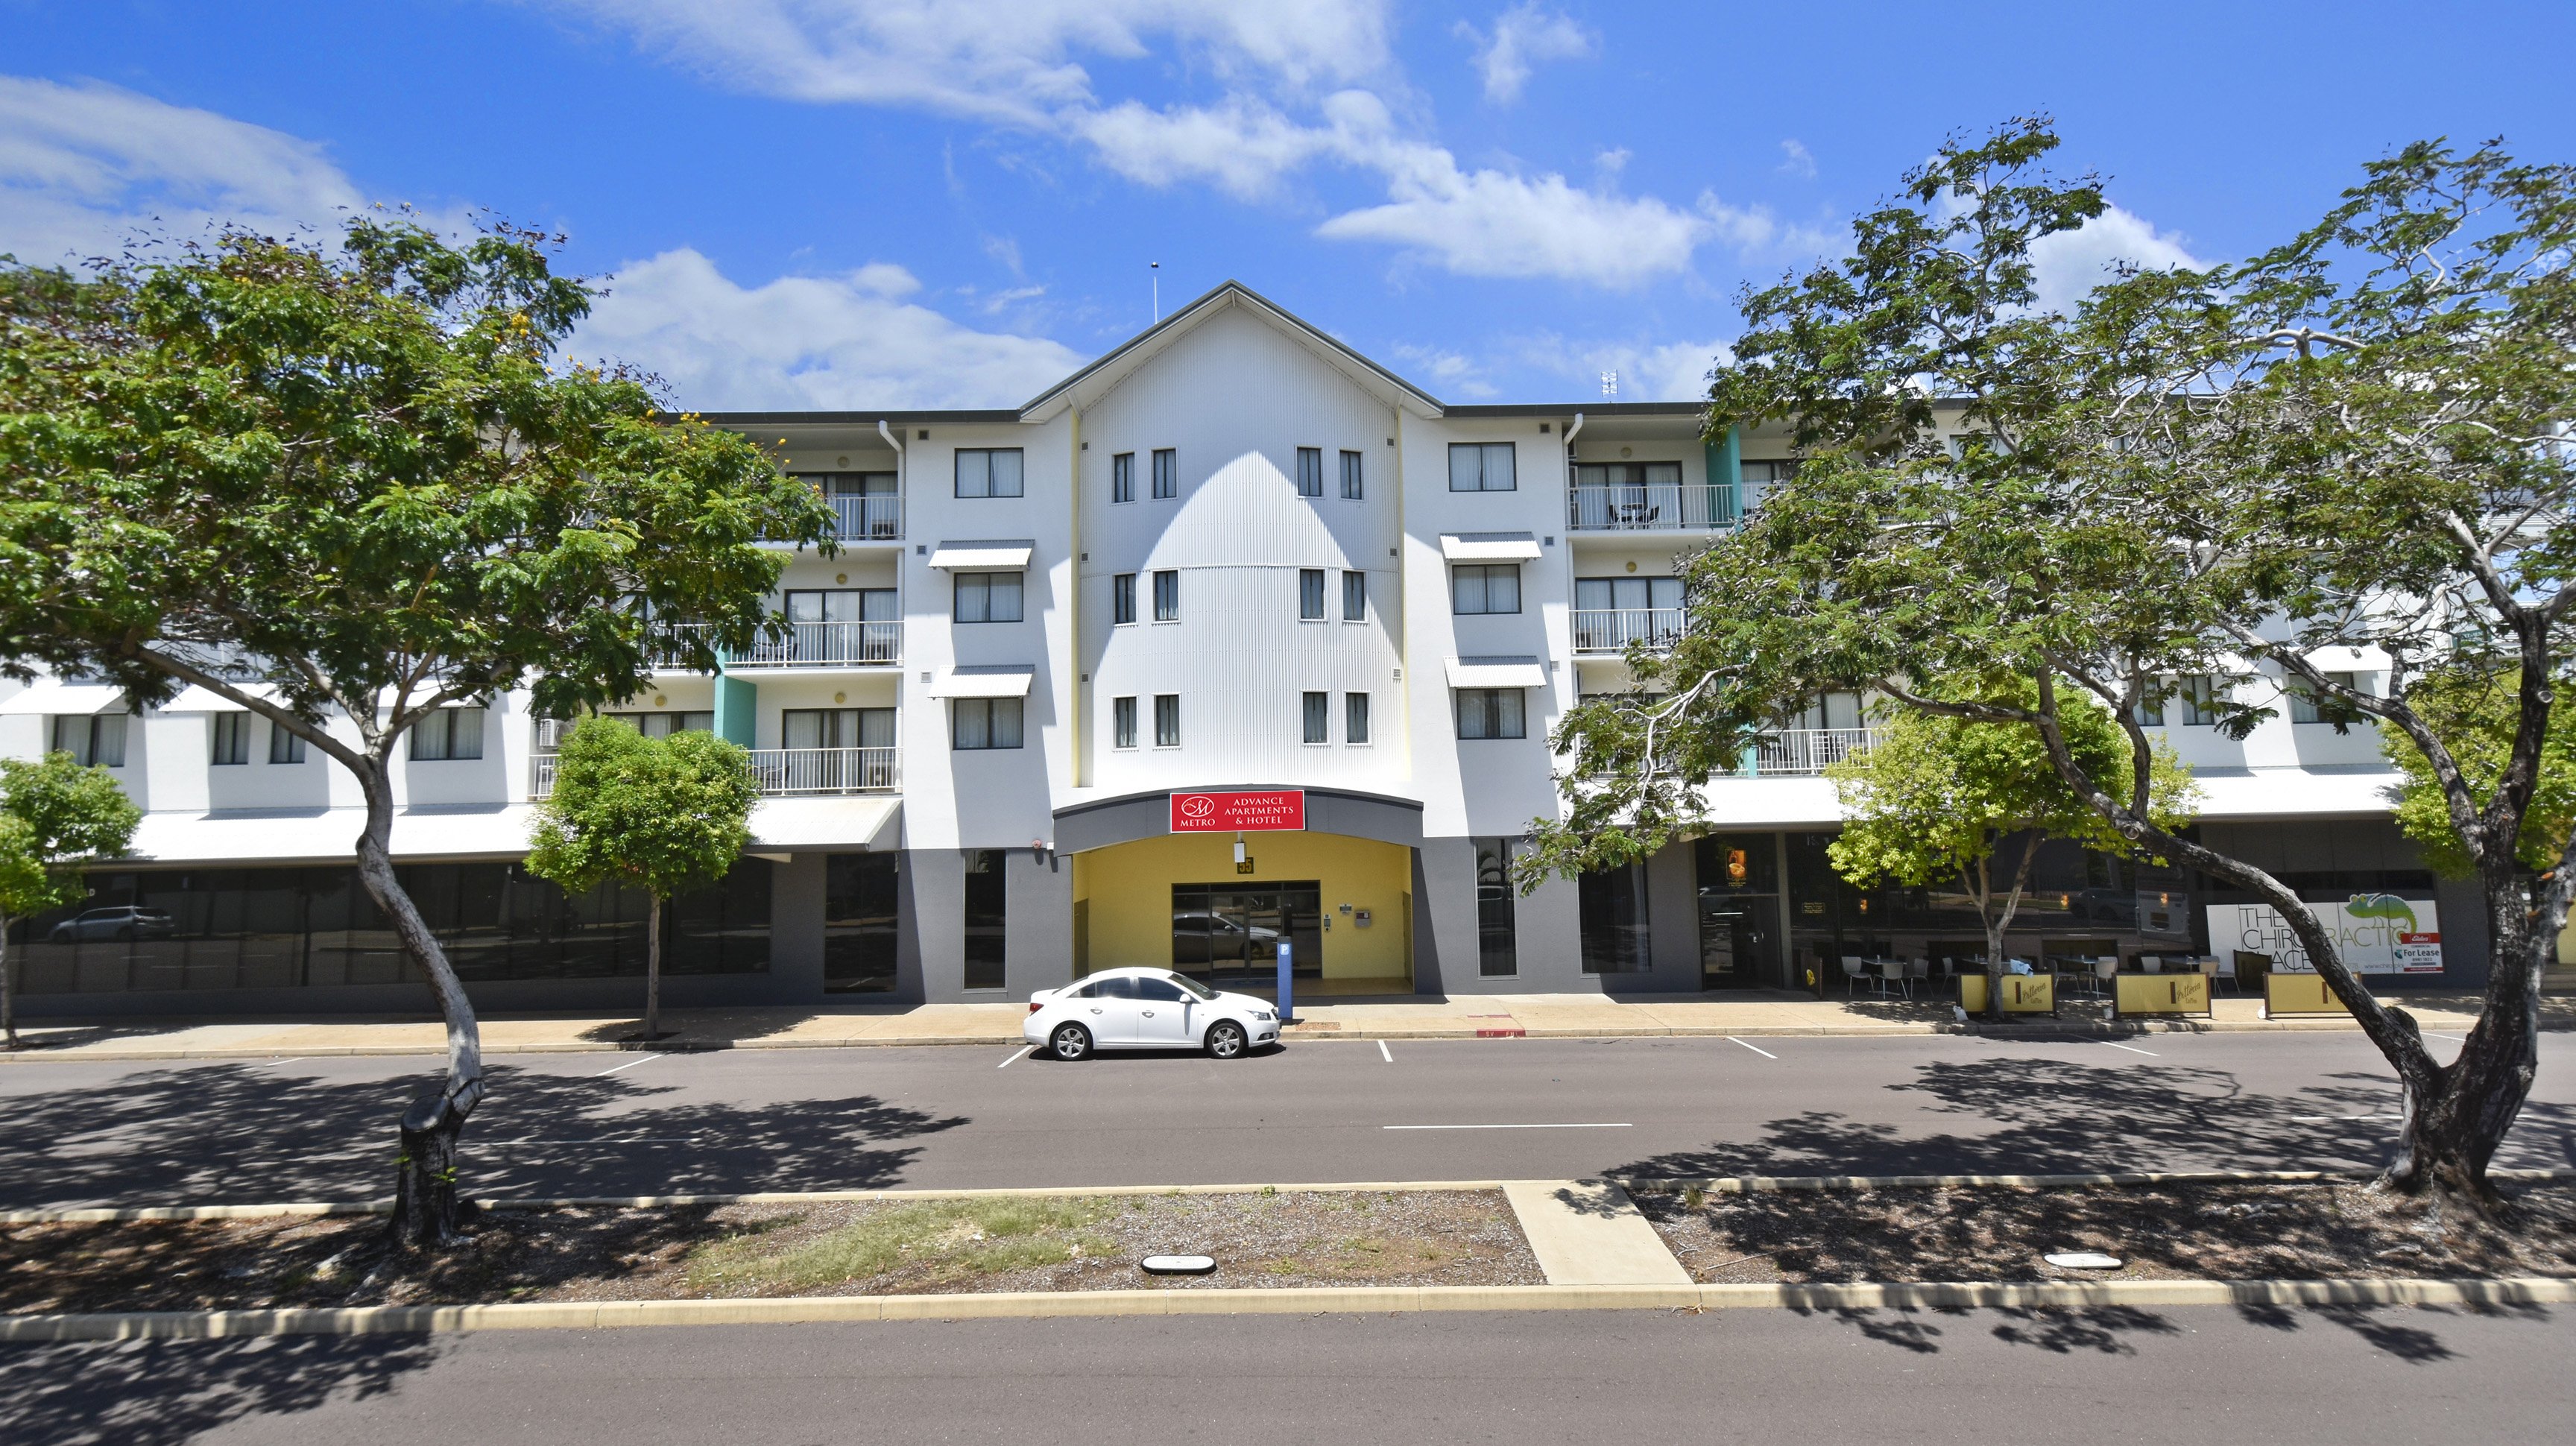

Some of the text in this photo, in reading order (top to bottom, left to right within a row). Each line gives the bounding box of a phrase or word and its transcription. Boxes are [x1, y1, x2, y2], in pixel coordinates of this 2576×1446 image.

[1234, 797, 1284, 806] ADVANCE
[1225, 806, 1294, 815] APARTMENTS
[1180, 818, 1216, 827] METRO
[1235, 816, 1283, 825] & HOTEL
[1240, 859, 1251, 872] 55
[2404, 949, 2416, 957] For
